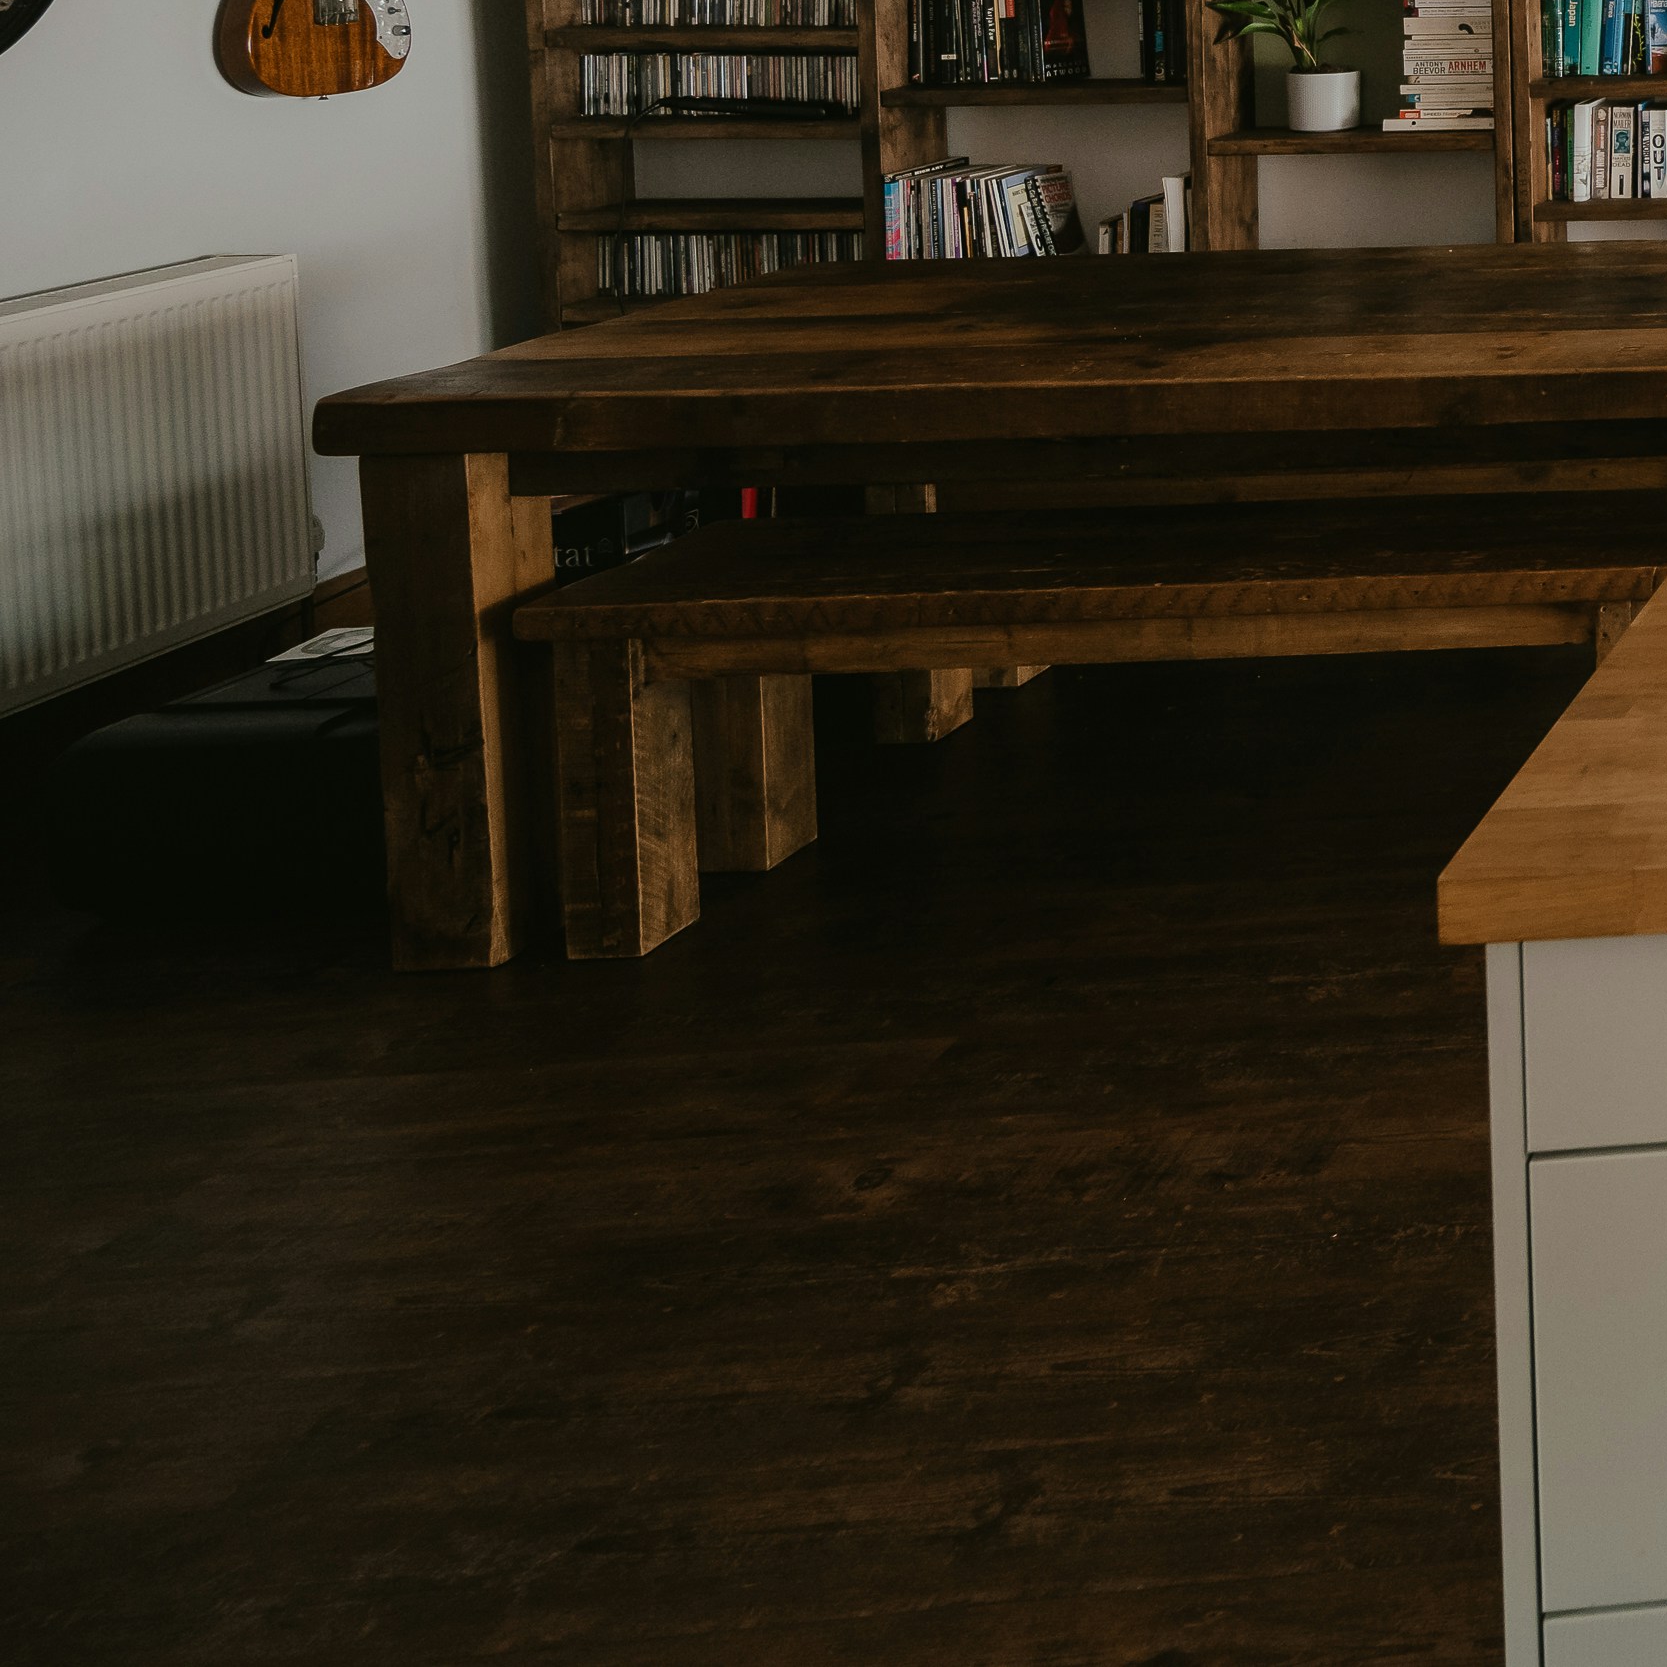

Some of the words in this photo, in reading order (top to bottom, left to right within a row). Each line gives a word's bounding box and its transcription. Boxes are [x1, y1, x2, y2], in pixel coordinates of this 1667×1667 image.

[986, 7, 994, 27] Varjak
[1568, 0, 1578, 27] Japan
[1448, 61, 1487, 70] ARNHEM
[1613, 120, 1632, 128] MAILER
[1596, 149, 1605, 167] JOHN
[1653, 134, 1665, 180] OUT
[1596, 168, 1605, 188] LYDON
